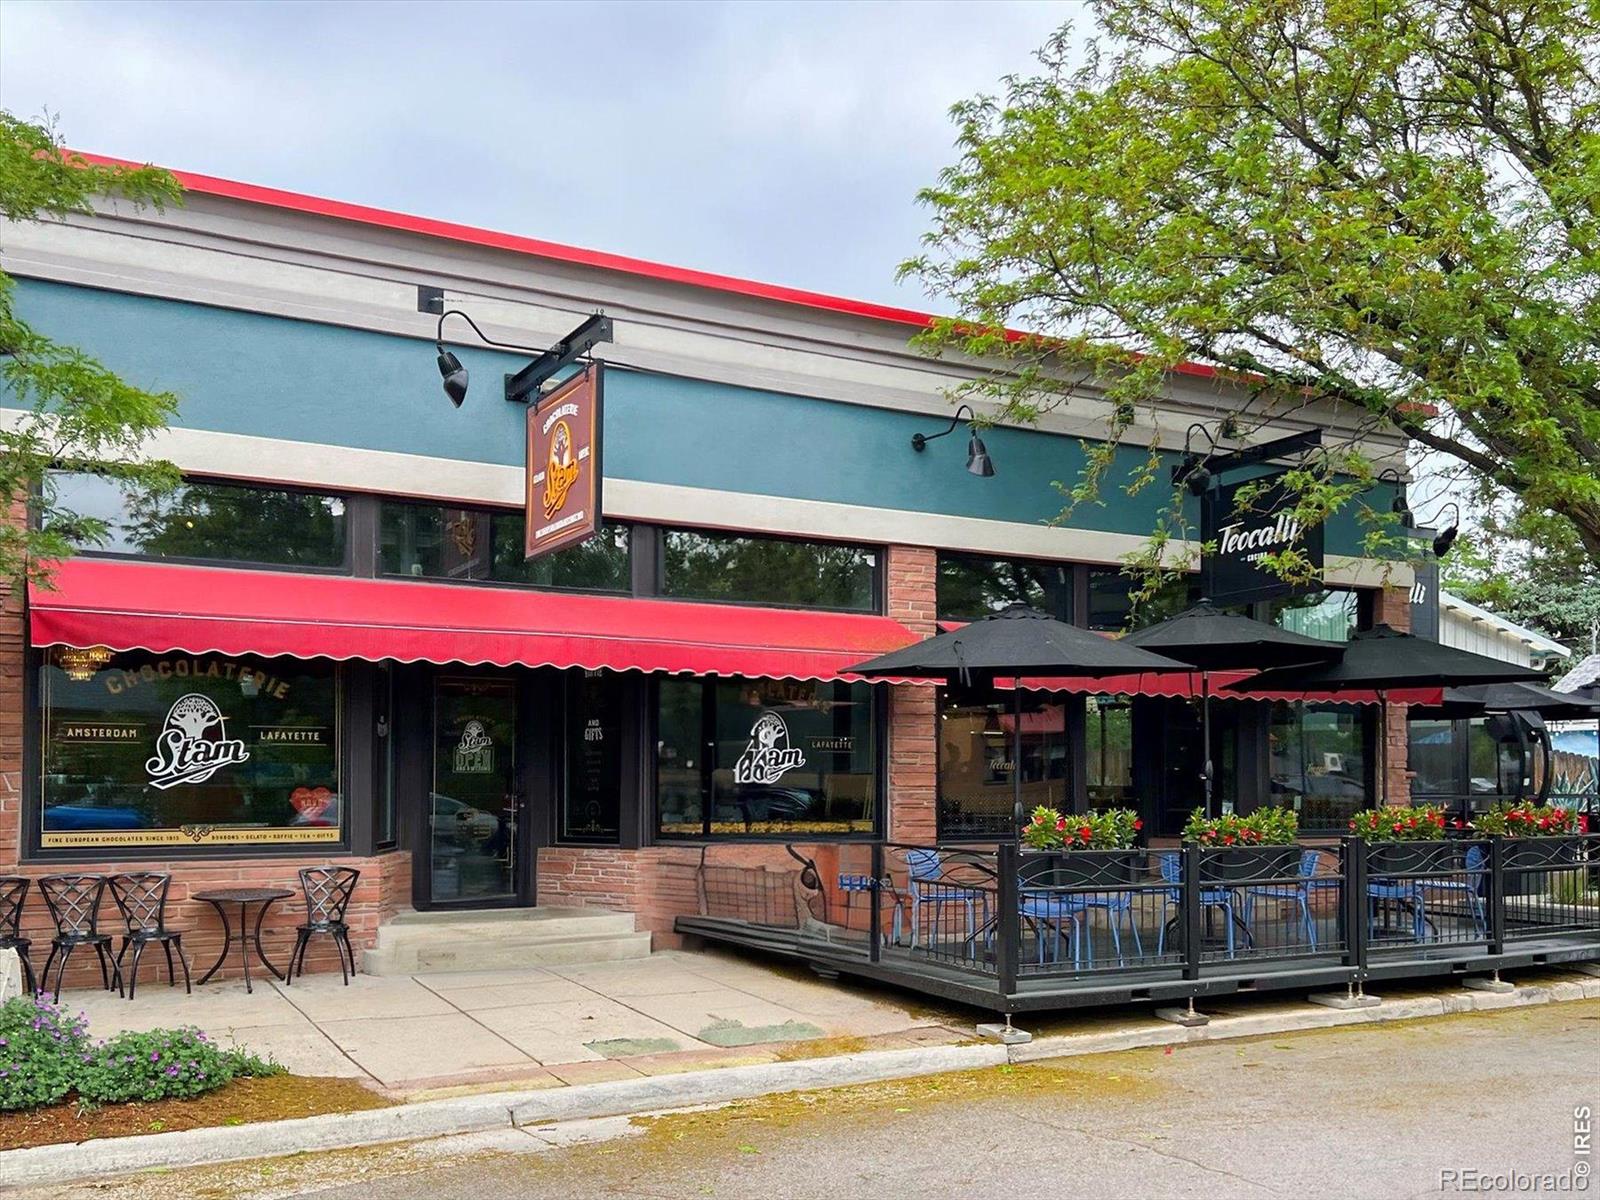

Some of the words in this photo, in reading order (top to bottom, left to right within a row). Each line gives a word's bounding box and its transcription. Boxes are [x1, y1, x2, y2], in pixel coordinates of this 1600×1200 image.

[105, 659, 291, 699] CHOCOLATERIE
[66, 727, 138, 739] AMSTERDAM
[260, 731, 320, 741] LAFAYETTE
[584, 727, 604, 741] GIFTS
[811, 741, 852, 749] LAFAYETTE
[145, 728, 250, 784] Stam
